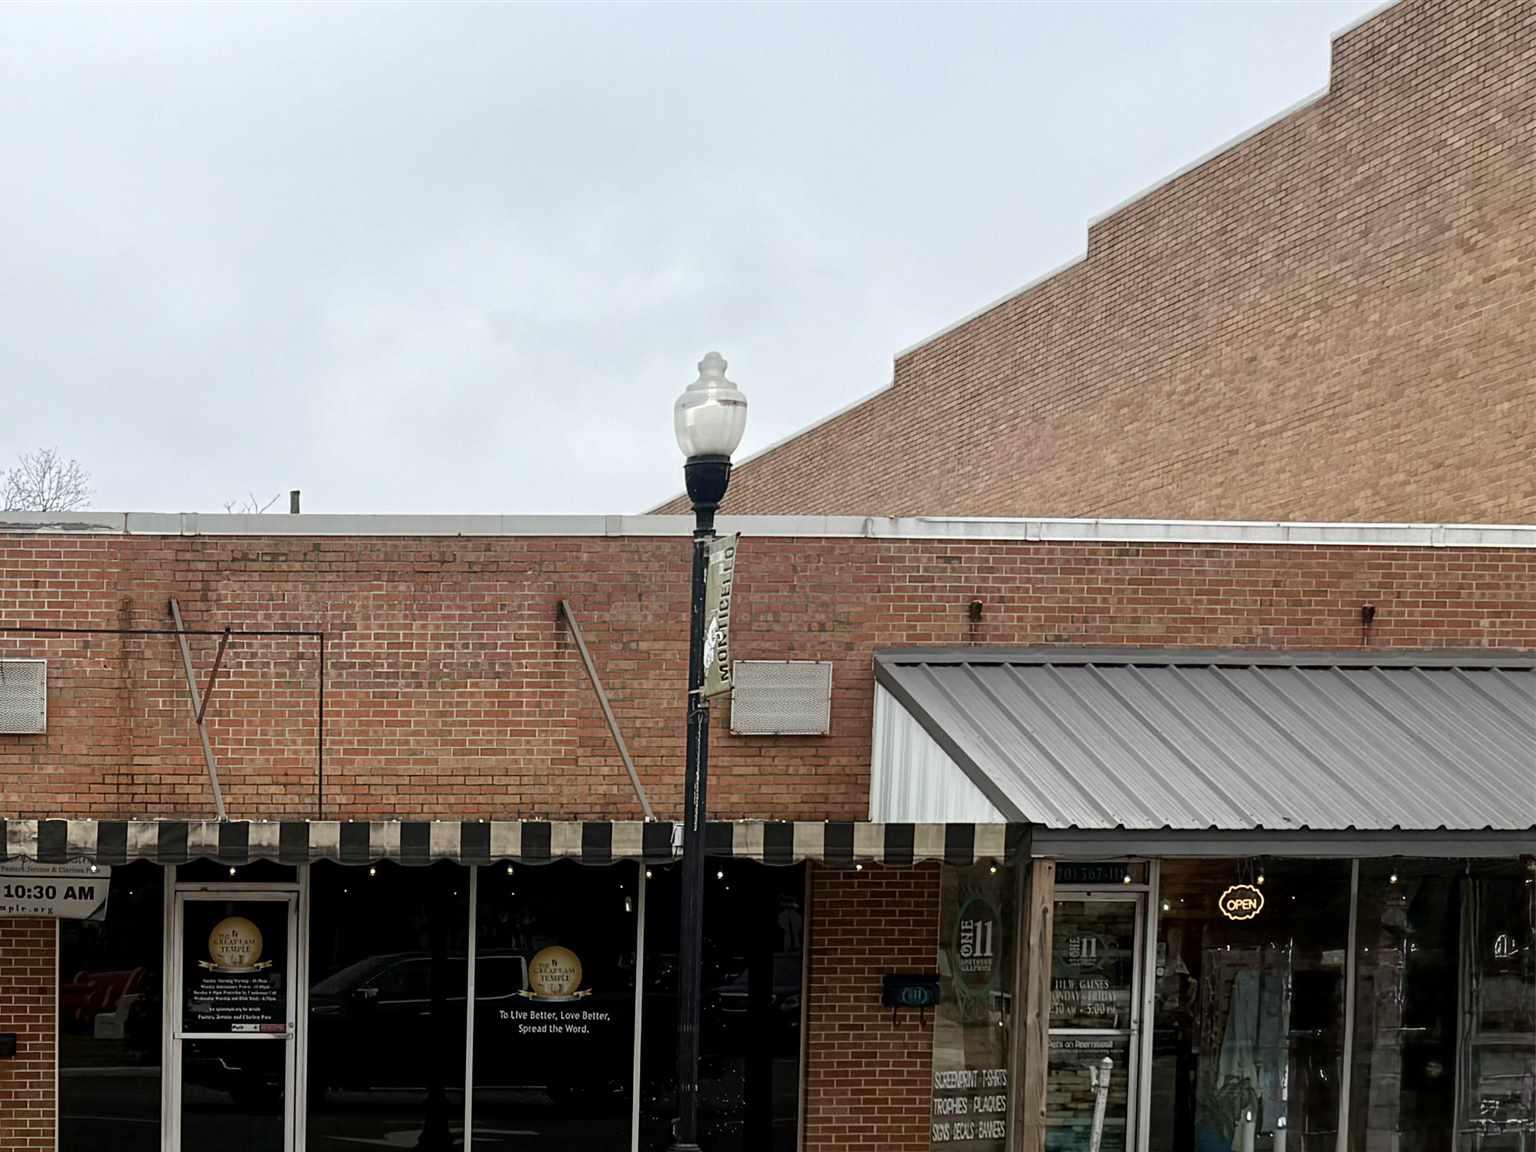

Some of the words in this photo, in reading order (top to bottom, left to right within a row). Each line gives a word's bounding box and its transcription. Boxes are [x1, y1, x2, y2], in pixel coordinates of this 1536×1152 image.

[4, 884, 57, 900] 10:30
[64, 886, 95, 900] AM
[1226, 898, 1257, 911] OPEN
[960, 920, 973, 958] ONE
[499, 1010, 509, 1019] To
[511, 1010, 528, 1019] Live
[530, 1010, 558, 1021] Better,
[560, 1010, 580, 1019] Love
[582, 1010, 611, 1021] Better,
[518, 1024, 547, 1034] Spread
[549, 1024, 563, 1033] the
[565, 1024, 590, 1033] Word.
[934, 1070, 978, 1089] SCREENPRINT
[933, 1097, 967, 1115] TROPHIES
[973, 1095, 1006, 1113] PLAQUES
[932, 1123, 950, 1142] SIGNS
[953, 1121, 975, 1140] DECALS
[978, 1120, 1005, 1139] BANNERS
